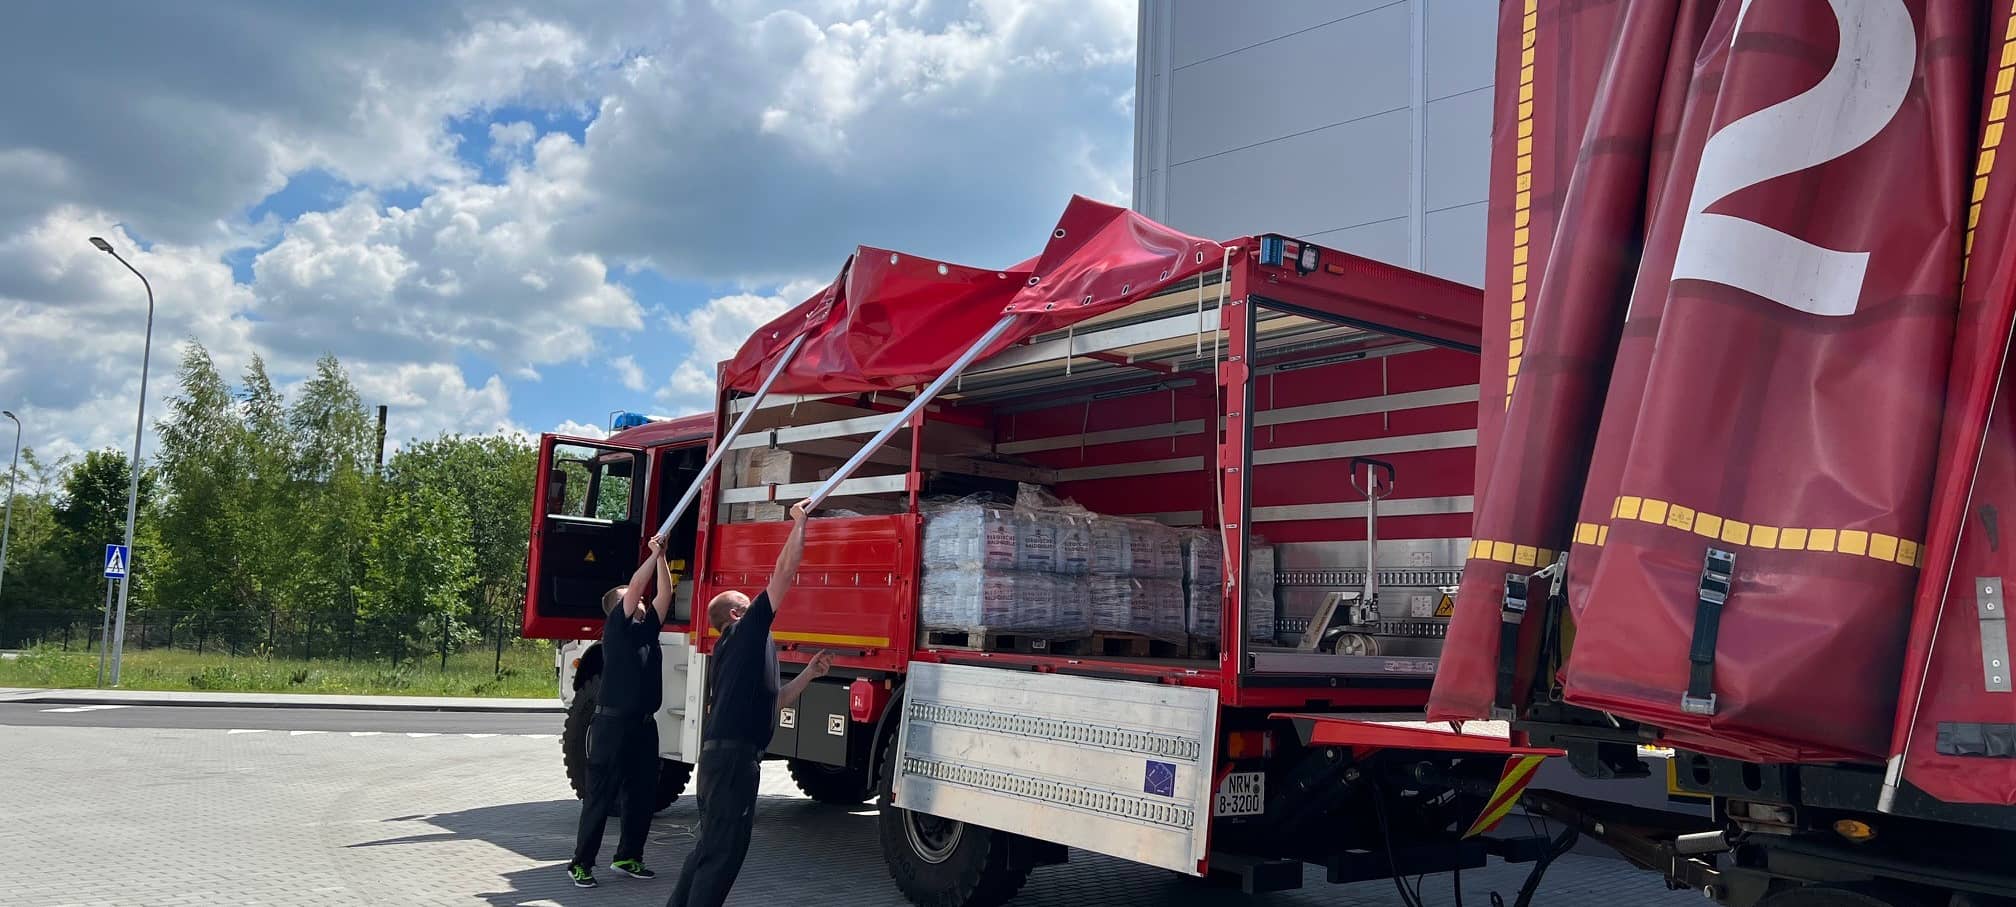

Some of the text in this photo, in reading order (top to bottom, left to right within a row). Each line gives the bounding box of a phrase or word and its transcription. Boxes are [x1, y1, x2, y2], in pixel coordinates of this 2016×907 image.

[1671, 0, 1917, 317] 2
[1229, 775, 1250, 793] NRW
[1220, 795, 1259, 813] 8-3200
